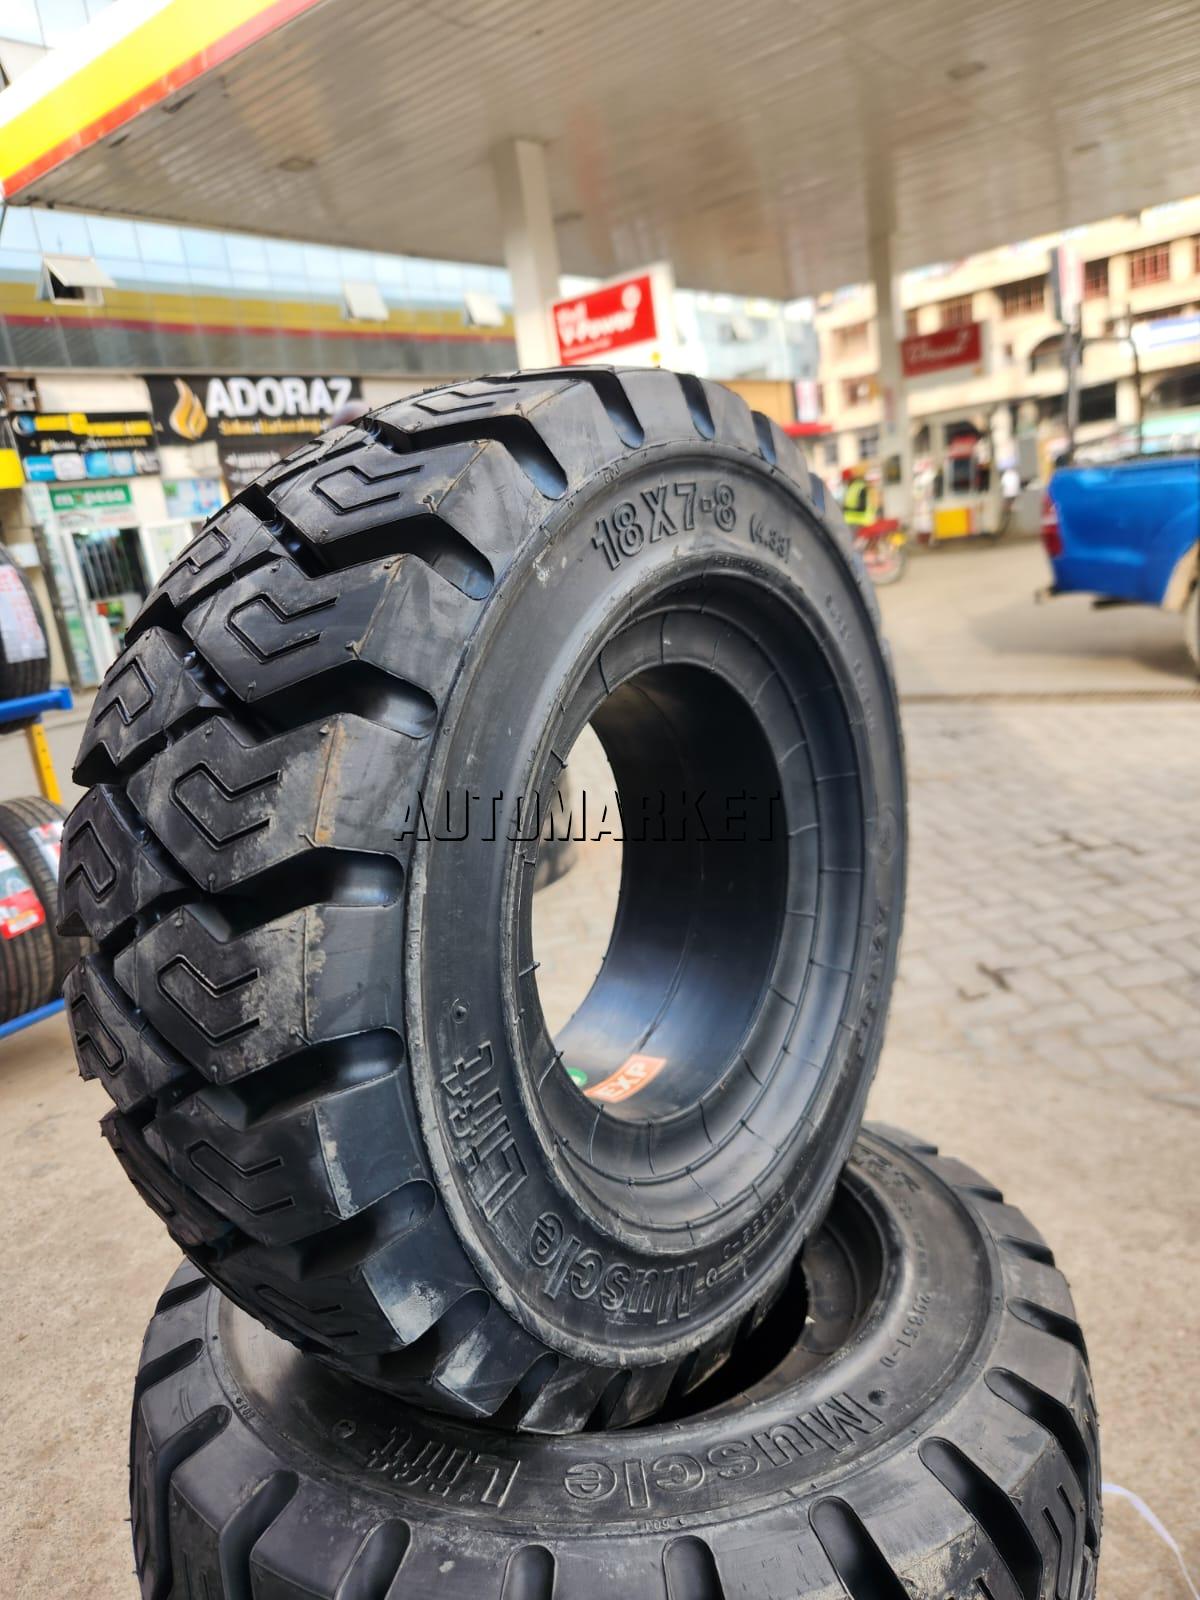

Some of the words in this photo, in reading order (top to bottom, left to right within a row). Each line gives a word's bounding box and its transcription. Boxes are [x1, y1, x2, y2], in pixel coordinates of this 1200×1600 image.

[591, 482, 737, 571] 18X7-8
[440, 1040, 529, 1222] Lift
[530, 1211, 698, 1326] Muscle
[563, 1391, 886, 1510] Muscle
